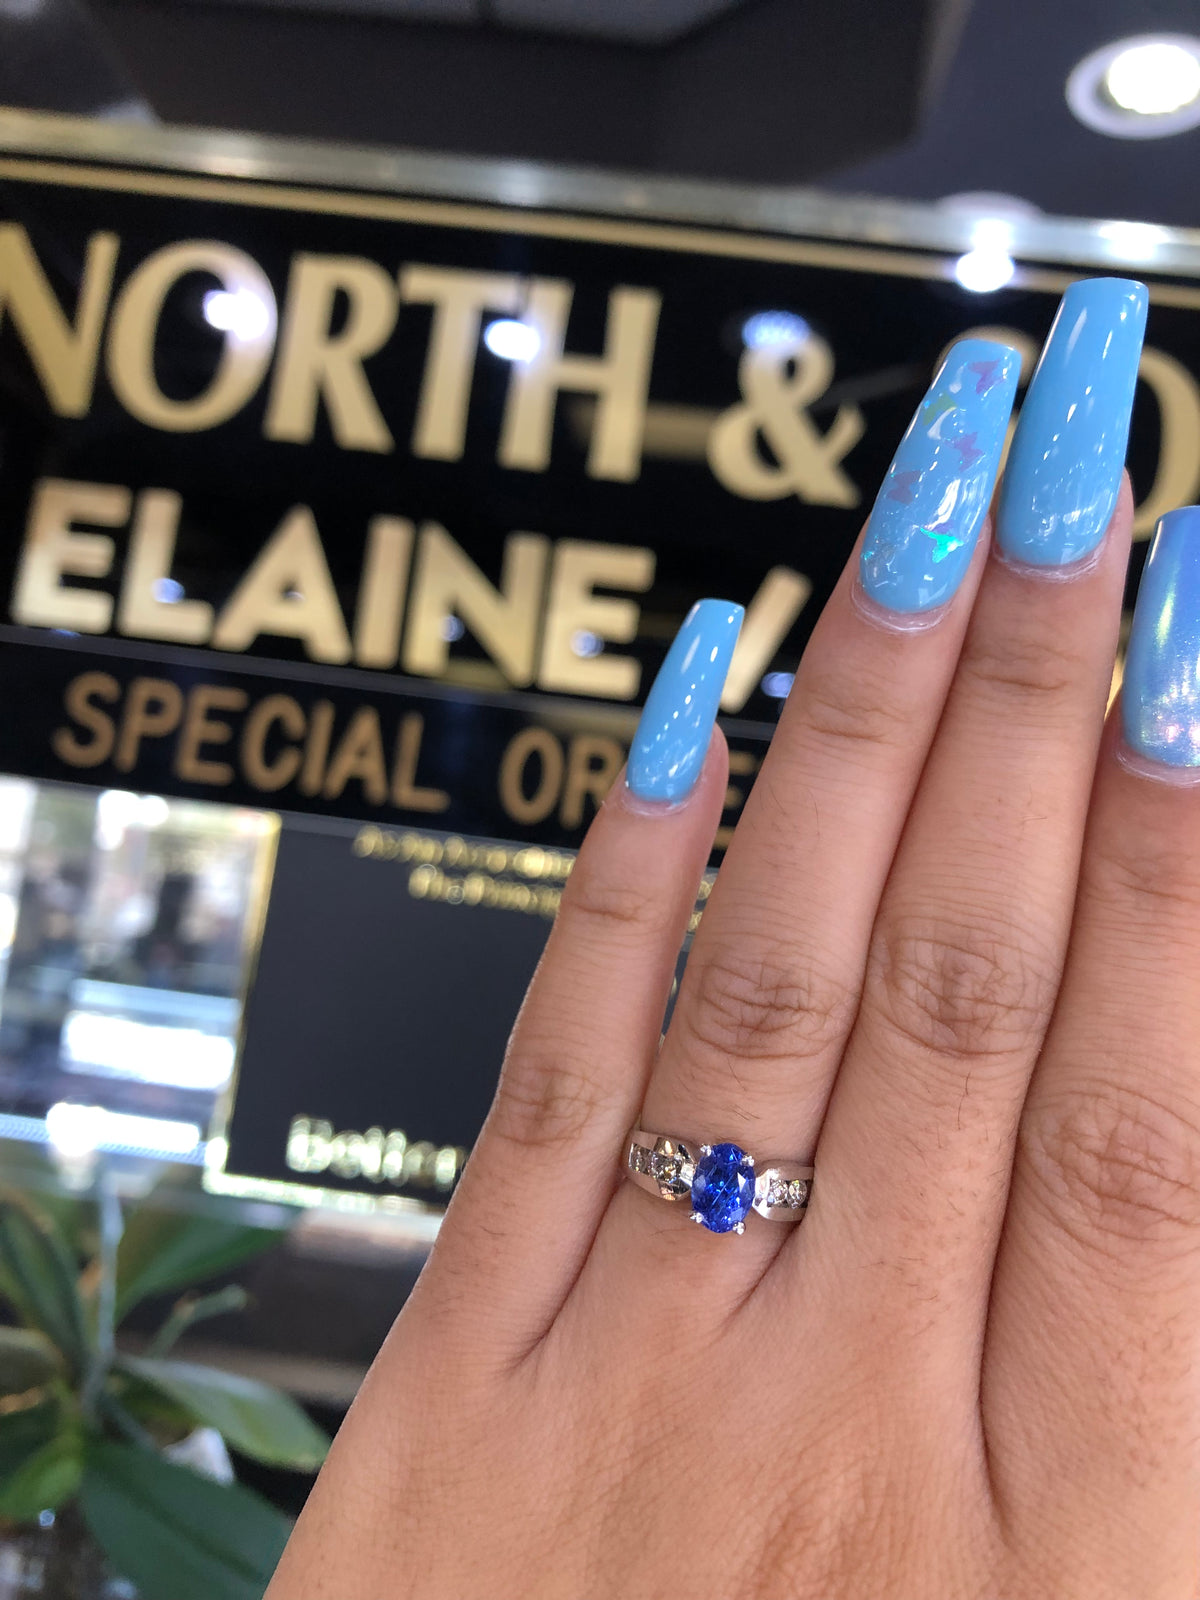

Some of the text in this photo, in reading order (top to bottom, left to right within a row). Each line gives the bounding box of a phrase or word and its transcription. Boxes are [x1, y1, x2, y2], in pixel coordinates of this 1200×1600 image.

[0, 222, 663, 483] NORTH
[708, 322, 866, 508] &
[12, 477, 656, 698] ELAINE
[52, 672, 451, 812] SPECIAL
